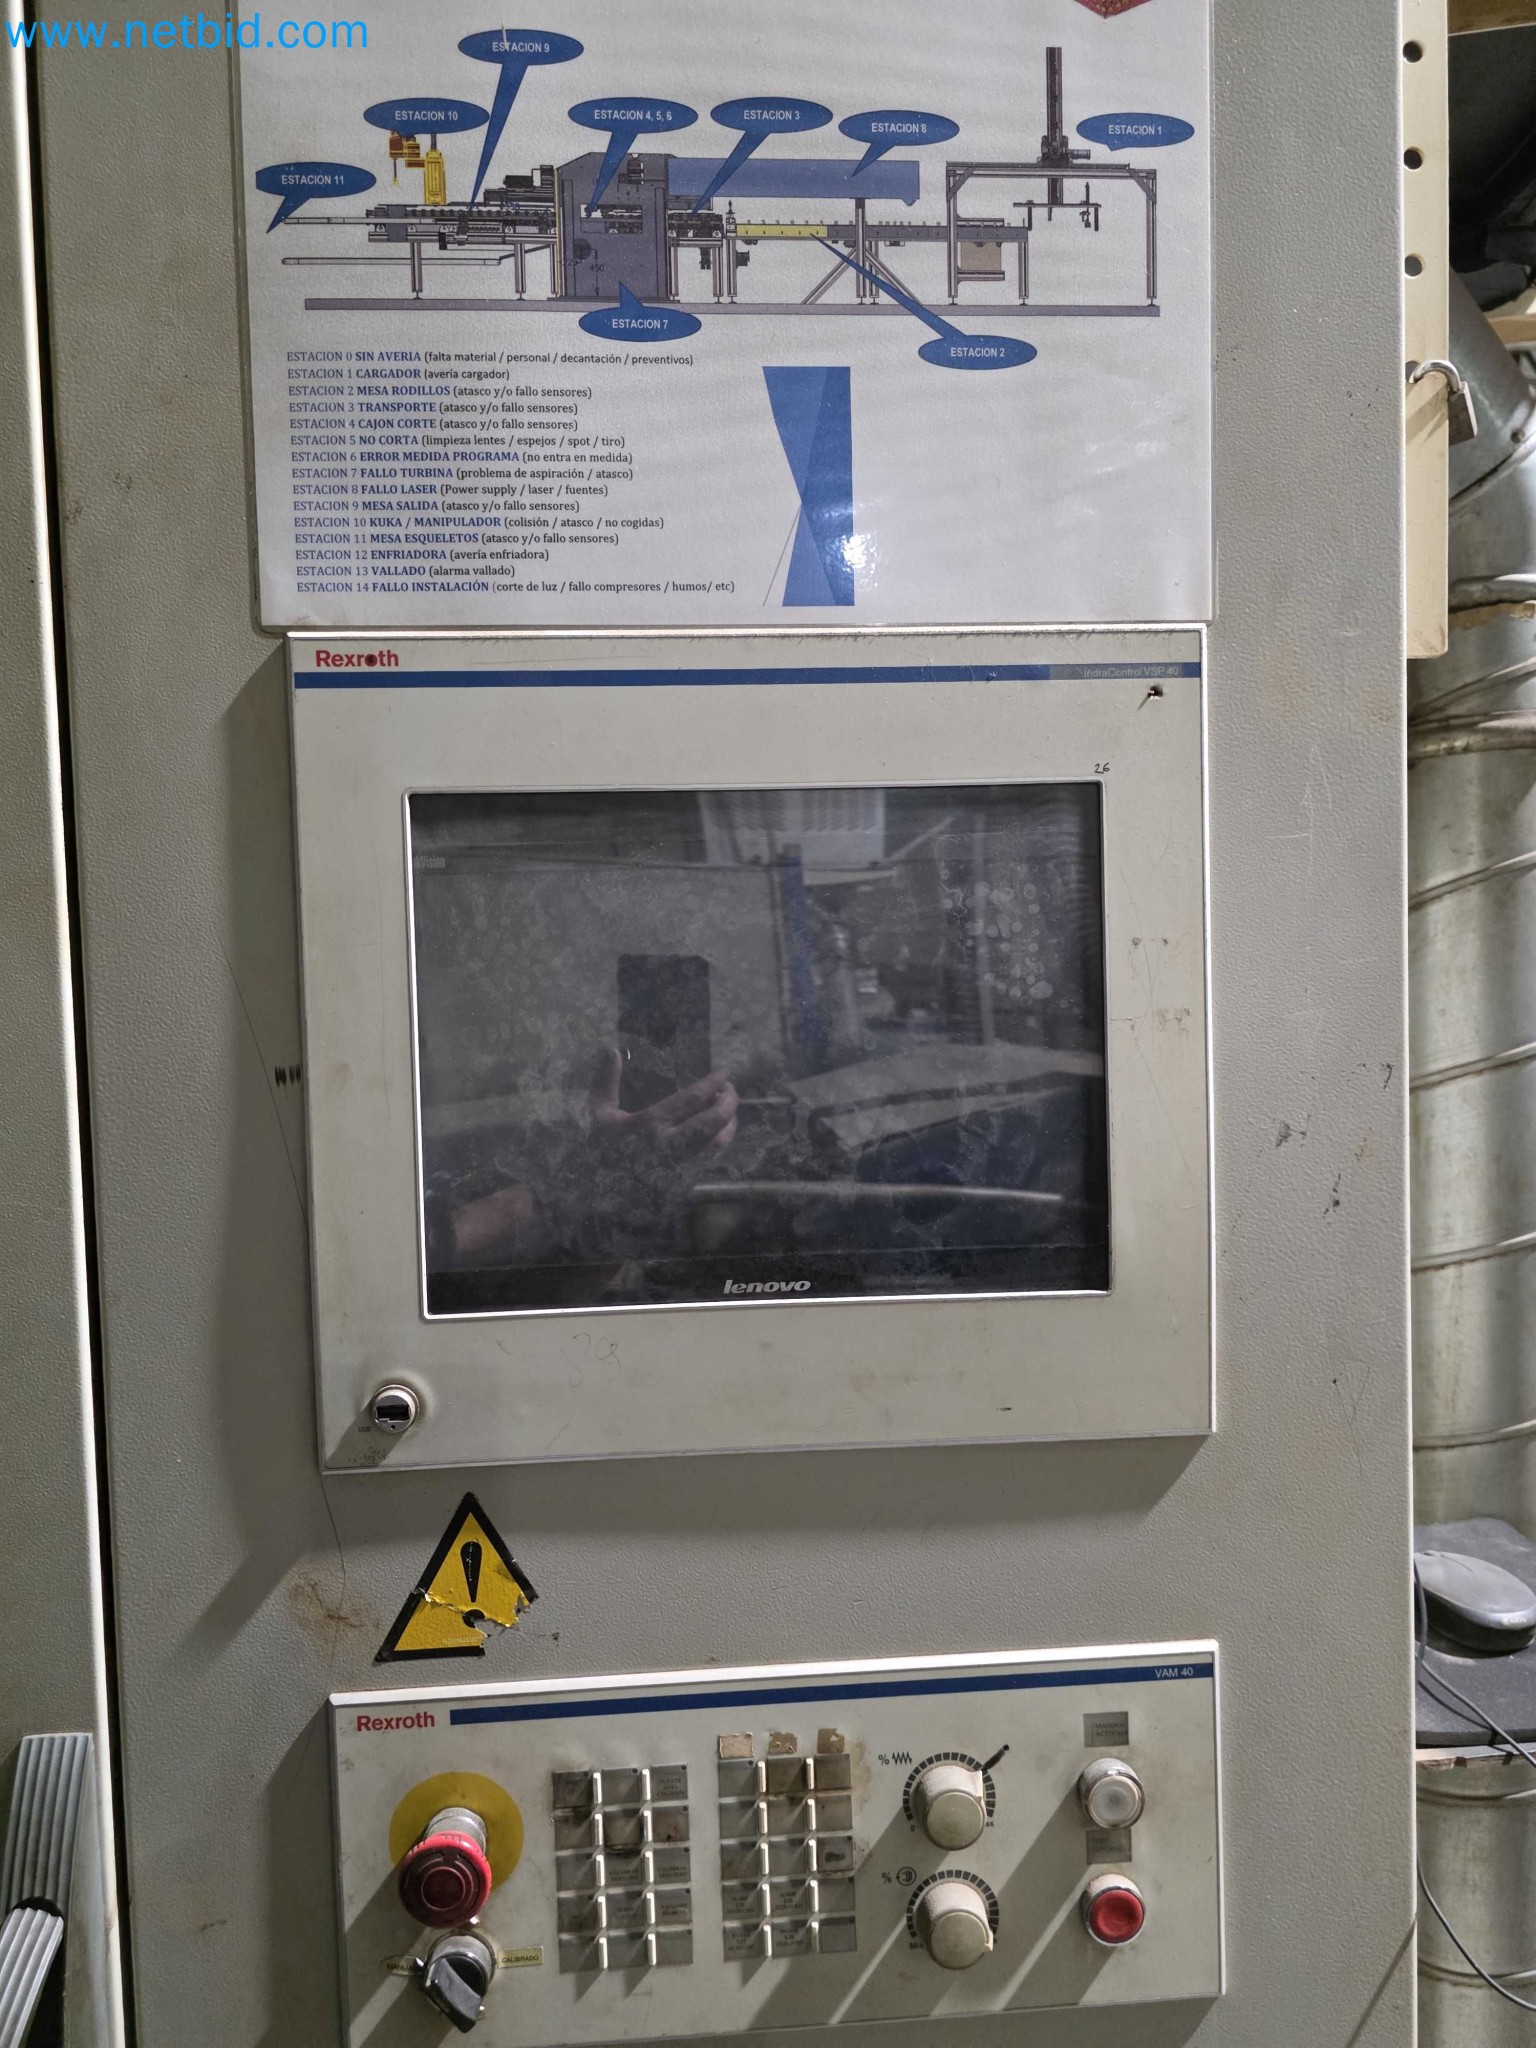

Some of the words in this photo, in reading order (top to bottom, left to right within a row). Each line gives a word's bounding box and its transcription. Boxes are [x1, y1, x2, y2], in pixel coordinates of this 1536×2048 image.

[492, 42, 542, 52] ESTACION
[544, 43, 549, 52] 9
[395, 110, 444, 120] ESTACION
[448, 111, 458, 120] 10
[594, 110, 643, 120] ESTACION
[646, 111, 653, 121] 4,
[656, 111, 664, 122] 5,
[666, 111, 672, 120] 6
[744, 110, 792, 120] ESTACION
[795, 111, 800, 120] 3
[872, 123, 919, 132] ESTACION
[922, 124, 926, 133] 8
[1109, 125, 1154, 134] ESTACION
[1158, 126, 1161, 134] 1
[282, 175, 331, 184] ESTACION
[334, 176, 344, 184] 11
[612, 319, 660, 329] ESTACION
[663, 320, 668, 329] 7
[287, 352, 342, 361] ESTACION
[345, 352, 352, 360] 0
[355, 351, 374, 361] SIN
[377, 351, 421, 361] AVERIA
[424, 351, 451, 363] (falta
[454, 352, 496, 361] material
[506, 353, 550, 363] personal
[560, 353, 621, 363] decantación
[631, 355, 693, 365] preventivos)
[951, 347, 997, 357] ESTACION
[1000, 348, 1004, 357] 2
[288, 369, 343, 378] ESTACION
[348, 369, 351, 378] 1
[356, 369, 421, 378] CARGADOR
[424, 369, 458, 379] (avería
[461, 369, 509, 380] cargador)
[288, 386, 344, 395] ESTACION
[347, 386, 353, 395] 2
[356, 386, 388, 395] MESA
[391, 386, 450, 395] RODILLOS
[453, 386, 491, 398] (atasco
[493, 386, 512, 398] y/o
[515, 386, 538, 396] fallo
[540, 387, 592, 399] sensores)
[289, 402, 344, 412] ESTACION
[348, 402, 354, 411] 3
[357, 402, 436, 412] TRANSPORTE
[439, 402, 477, 414] (atasco
[479, 402, 498, 414] y/o
[501, 402, 524, 412] fallo
[526, 403, 577, 415] sensores)
[290, 419, 345, 428] ESTACION
[348, 419, 355, 428] 4
[358, 419, 394, 430] CAJON
[397, 419, 436, 428] CORTE
[439, 419, 477, 430] (atasco
[479, 419, 499, 431] y/o
[501, 418, 524, 428] fallo
[527, 420, 577, 431] sensores)
[290, 435, 345, 445] ESTACION
[349, 435, 355, 444] 5
[359, 435, 375, 445] NO
[378, 435, 418, 444] CORTA
[421, 435, 471, 447] (limpieza
[473, 435, 505, 445] lentes
[516, 436, 556, 447] espejos
[567, 437, 590, 448] spot
[601, 436, 625, 448] tiro)
[291, 452, 346, 461] ESTACION
[350, 452, 356, 461] 6
[359, 452, 400, 461] ERROR
[402, 451, 449, 461] MEDIDA
[452, 451, 519, 461] PROGRAMA
[522, 451, 540, 463] (no
[542, 453, 571, 461] entra
[589, 452, 632, 464] medida)
[292, 468, 347, 477] ESTACION
[351, 468, 357, 477] 7
[360, 468, 397, 477] FALLO
[399, 468, 453, 477] TURBINA
[456, 468, 511, 480] (problema
[514, 468, 527, 477] de
[529, 468, 584, 480] aspiración
[595, 469, 633, 480] atasco)
[293, 485, 348, 494] ESTACION
[351, 485, 358, 494] 8
[361, 485, 397, 494] FALLO
[401, 484, 437, 494] LASER
[440, 484, 479, 496] (Power
[481, 484, 517, 496] supply
[528, 484, 554, 494] laser
[565, 484, 608, 496] fuentes)
[293, 501, 348, 510] ESTACION
[352, 501, 358, 510] 9
[361, 501, 393, 510] MESA
[396, 501, 438, 510] SALIDA
[441, 500, 479, 512] (atasco
[481, 500, 500, 512] y/o
[503, 500, 526, 510] fallo
[528, 501, 579, 512] sensores)
[294, 517, 349, 527] ESTACION
[353, 517, 366, 527] 10
[369, 517, 402, 527] KUKA
[414, 517, 501, 526] MANIPULADOR
[504, 516, 549, 529] (colisión
[560, 518, 593, 527] atasco
[620, 517, 663, 529] cogidas)
[295, 533, 350, 543] ESTACION
[354, 534, 366, 543] 11
[370, 534, 401, 543] MESA
[404, 533, 478, 544] ESQUELETOS
[481, 533, 519, 545] (atasco
[521, 533, 540, 545] y/o
[543, 532, 566, 543] fallo
[568, 534, 618, 545] sensores)
[295, 550, 350, 559] ESTACION
[355, 550, 367, 559] 12
[370, 550, 447, 559] ENFRIADORA
[449, 549, 487, 561] (avería
[489, 549, 549, 561] enfriadora)
[296, 566, 351, 575] ESTACION
[356, 566, 368, 575] 13
[371, 566, 425, 575] VALLADO
[429, 566, 470, 577] (alarma
[472, 565, 514, 577] vallado)
[297, 582, 352, 592] ESTACION
[357, 582, 369, 591] 14
[372, 582, 408, 591] FALLO
[411, 580, 488, 591] INSTALACIÓN
[492, 582, 523, 594] (corte
[526, 581, 539, 591] de
[541, 581, 557, 591] luz
[568, 581, 591, 591] fallo
[593, 584, 660, 593] compresores
[715, 581, 734, 593] etc)
[315, 649, 399, 667] Rexroth
[1084, 667, 1142, 678] IndraControl
[1143, 668, 1164, 677] VSP
[1166, 667, 1179, 676] 40
[1094, 762, 1110, 774] 26
[723, 1280, 811, 1294] lenovo
[1155, 1668, 1178, 1678] VAM
[1181, 1667, 1193, 1677] 40
[357, 1712, 435, 1731] Rexroth
[502, 1954, 539, 1963] CALIBRADO
[387, 1963, 414, 1971] MANUA
